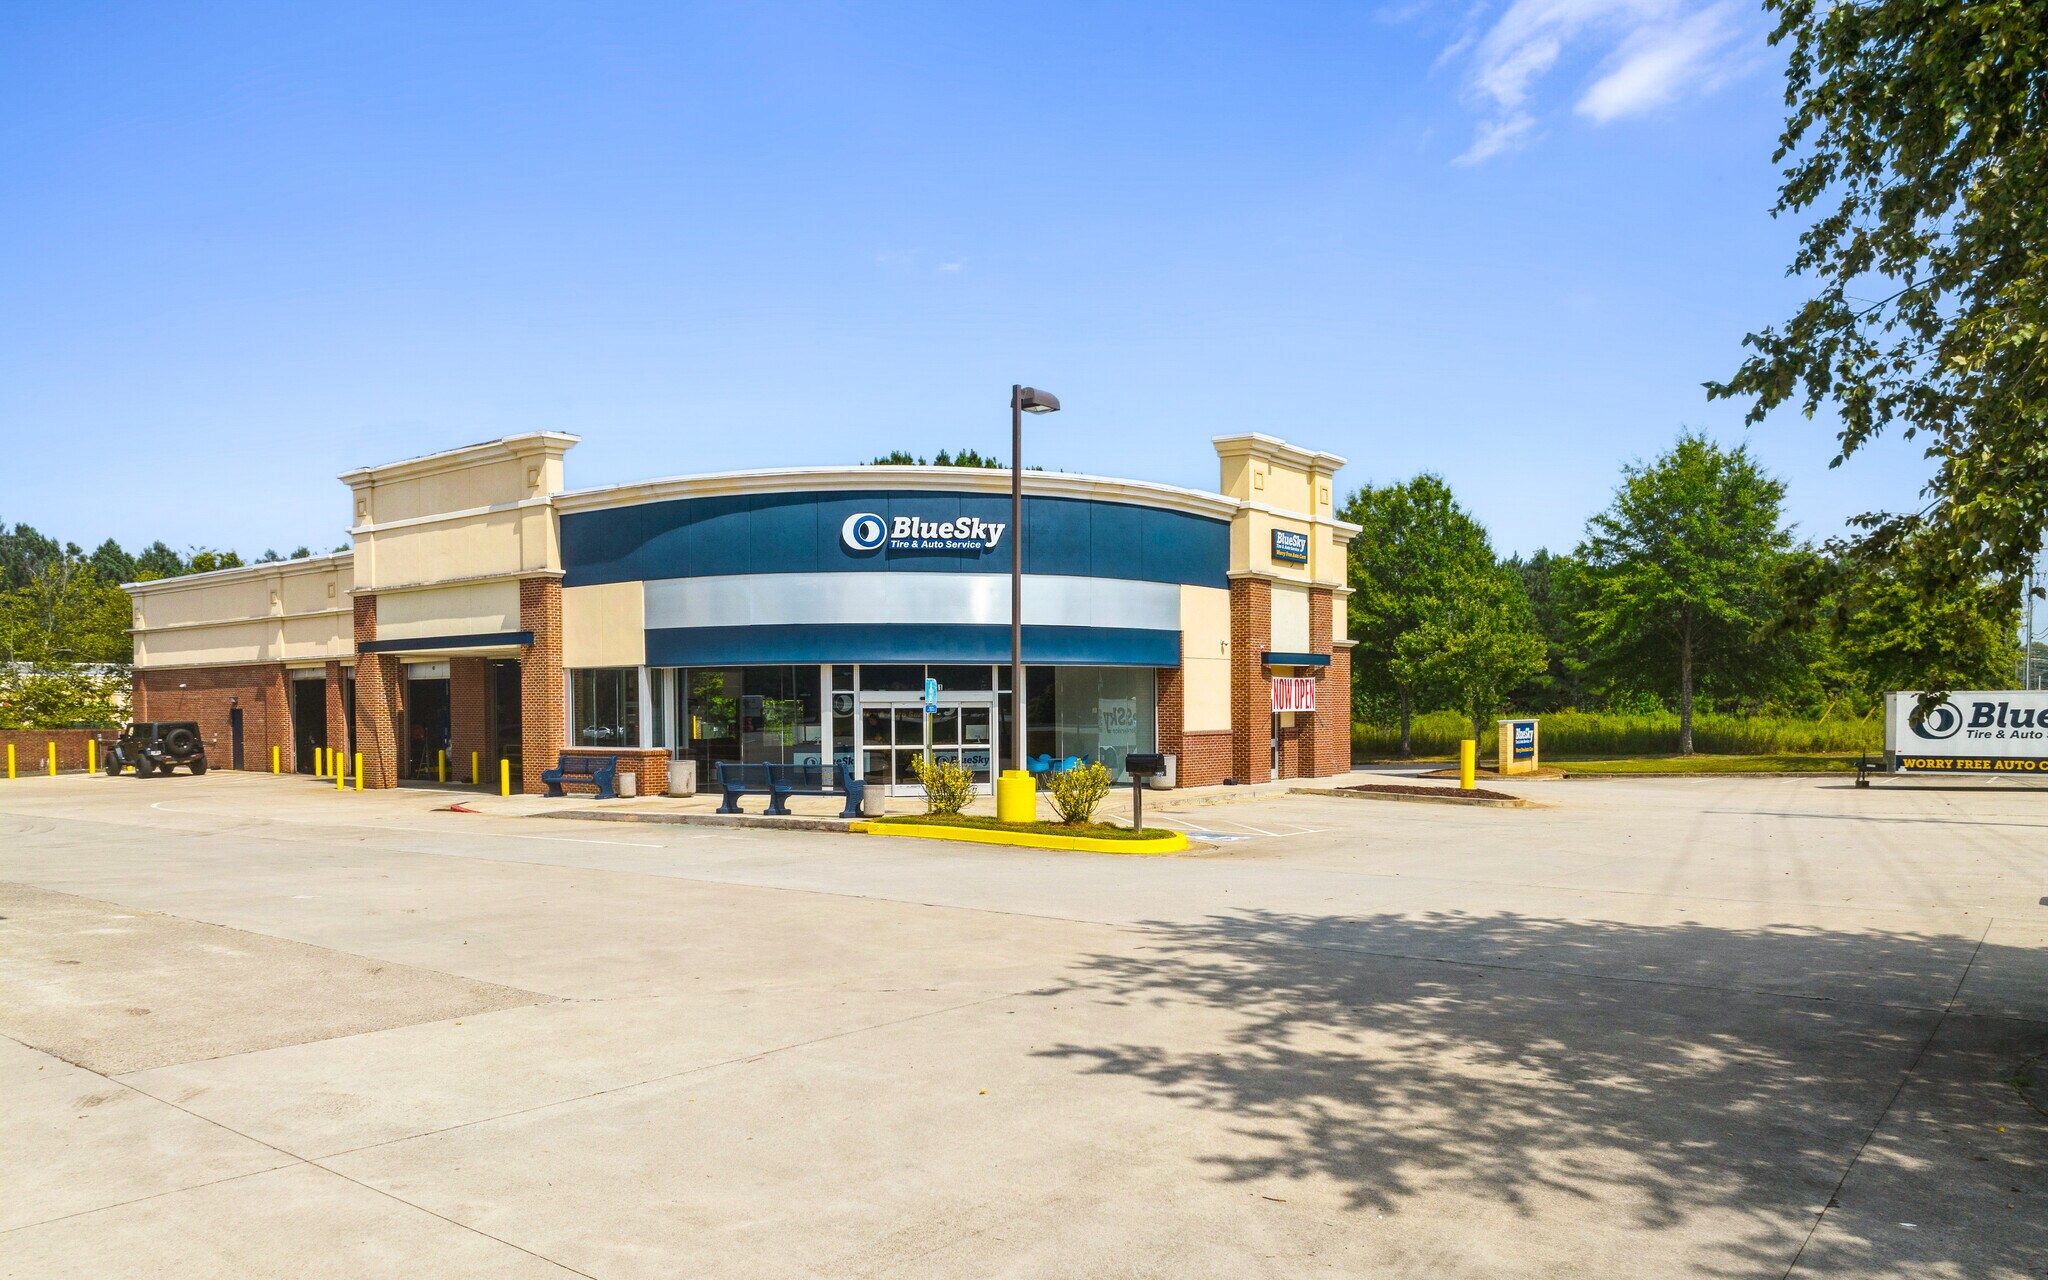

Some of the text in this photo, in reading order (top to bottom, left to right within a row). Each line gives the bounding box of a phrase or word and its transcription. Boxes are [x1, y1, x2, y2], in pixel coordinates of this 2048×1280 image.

[891, 516, 1006, 548] BlueSky
[891, 540, 981, 548] Tire & Auto Service
[1276, 531, 1306, 552] BlueSky
[1273, 678, 1315, 710] NOW OPEN
[1515, 727, 1533, 743] BlueSky
[1966, 729, 1992, 739] Tire
[1995, 729, 2006, 739] &
[2010, 730, 2043, 740] Auto
[950, 755, 989, 767] BueSky
[1902, 758, 1953, 769] WORRY
[1956, 759, 1991, 770] FREE
[1993, 760, 2036, 771] AUTO
